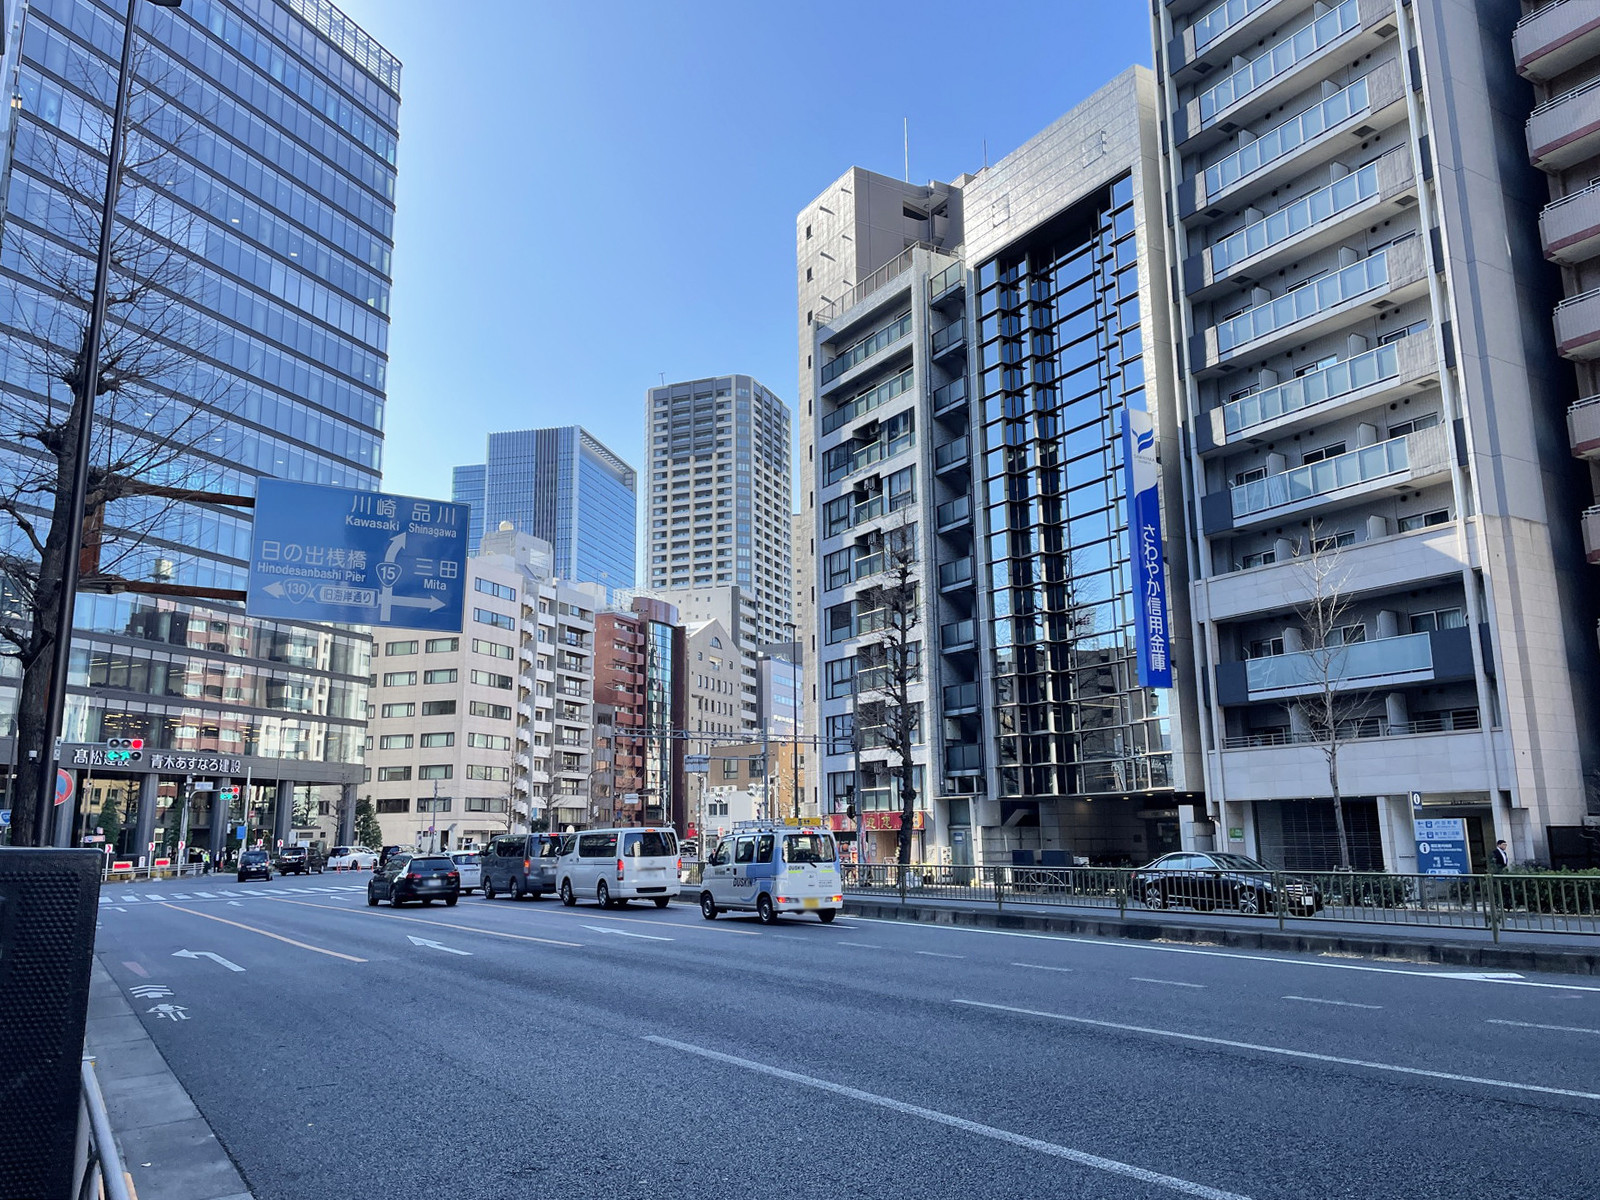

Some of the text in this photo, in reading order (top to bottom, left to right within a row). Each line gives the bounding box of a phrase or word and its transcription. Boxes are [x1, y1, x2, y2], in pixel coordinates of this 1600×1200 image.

[351, 494, 397, 519] 川崎
[411, 502, 456, 526] 品川
[345, 515, 400, 531] Kawasaki
[408, 522, 457, 539] Shinagawa
[261, 540, 367, 571] 日の出桟橋
[257, 561, 367, 583] Hinodesanbashi Pier
[380, 566, 396, 580] 15
[413, 557, 458, 579] 三田
[286, 582, 307, 596] 130
[423, 578, 447, 591] Mita
[323, 588, 372, 605] 旧海岸通り
[1142, 523, 1167, 673] さわやか信用金庫
[151, 754, 241, 774] 青木あすなろ建設
